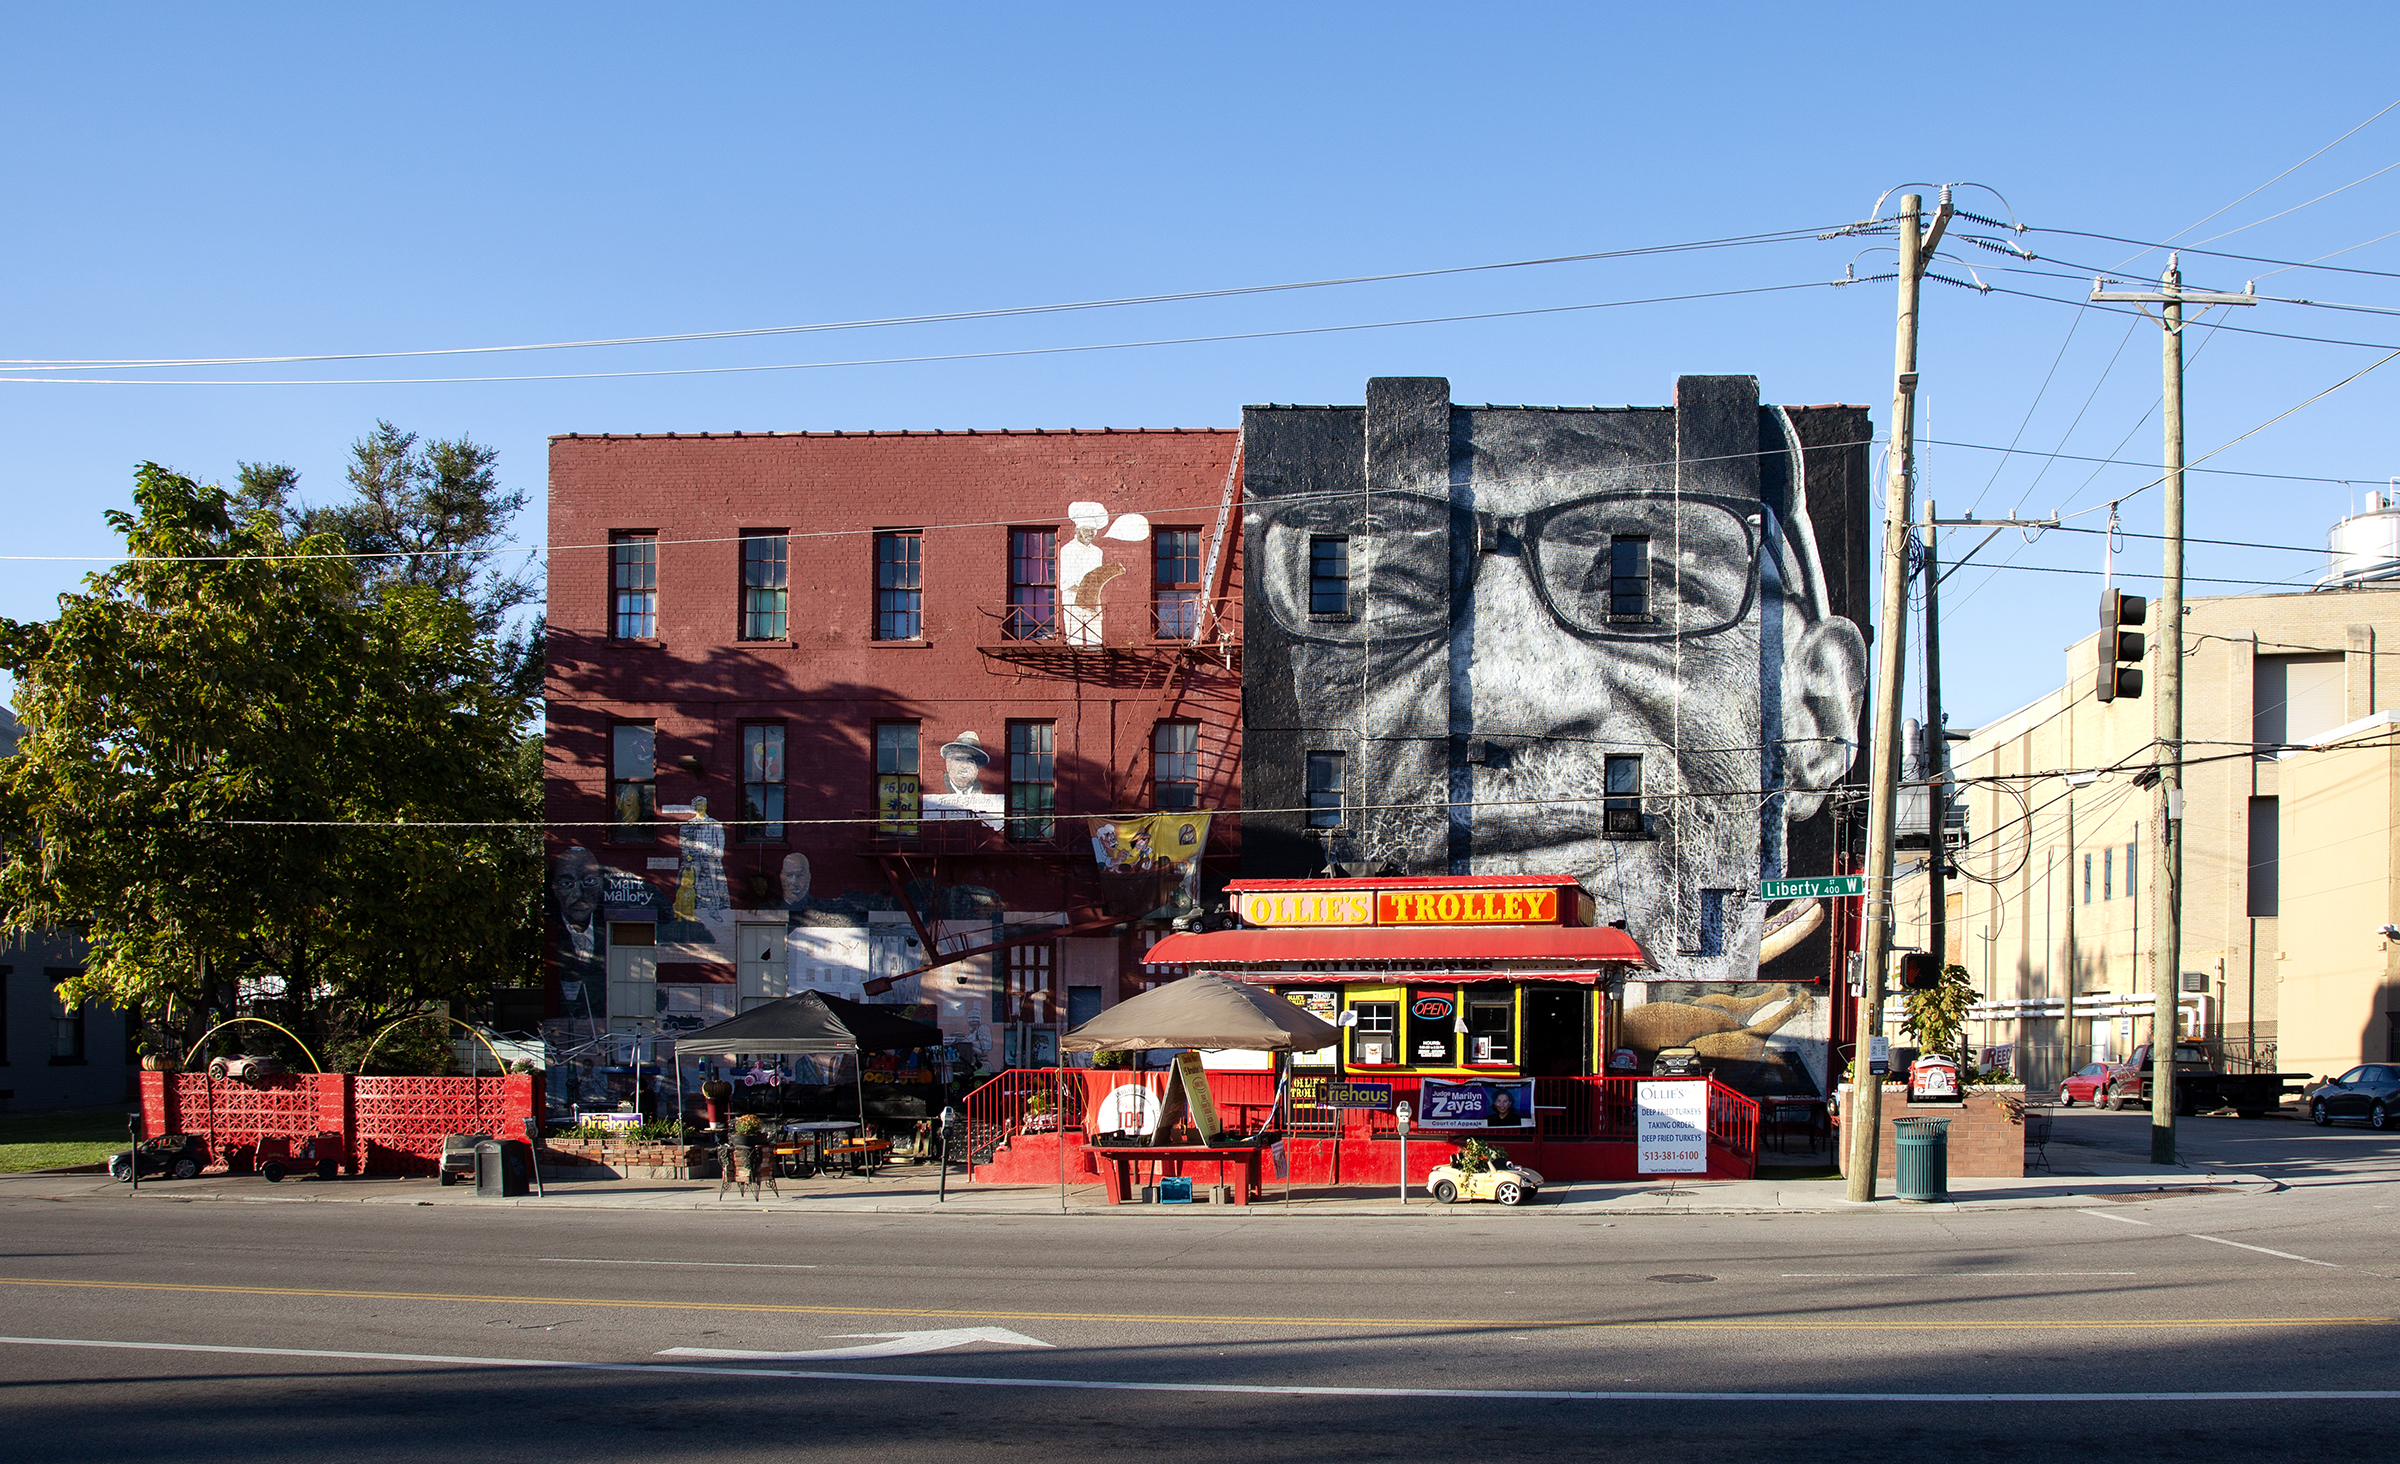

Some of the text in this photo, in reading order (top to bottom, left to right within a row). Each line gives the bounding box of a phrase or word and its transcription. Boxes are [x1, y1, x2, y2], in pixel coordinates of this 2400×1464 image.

[884, 783, 915, 793] $6.00
[609, 879, 645, 890] Mark
[1767, 880, 1820, 897] Liberty
[1824, 886, 1840, 894] 400
[1846, 878, 1858, 893] W
[603, 889, 654, 905] Mallory
[1249, 896, 1368, 923] OLLIE'S
[1391, 893, 1549, 921] TROLLEY
[1415, 1003, 1449, 1016] OPEN
[1290, 1088, 1316, 1099] TROLL
[1319, 1084, 1389, 1103] Driehaus
[1432, 1090, 1482, 1102] Judge Marilyn
[1640, 1087, 1685, 1101] OLLIE'S
[1432, 1097, 1482, 1117] Zayas
[1641, 1107, 1702, 1117] DEEP FRIED TURKEYS
[581, 1115, 640, 1131] Driehaus
[1119, 1111, 1145, 1129] 100
[1648, 1121, 1695, 1129] TAKING ORDERS
[1641, 1133, 1702, 1142] DEEP FRIED TURKEYS
[1644, 1150, 1699, 1161] 513-381-6100
